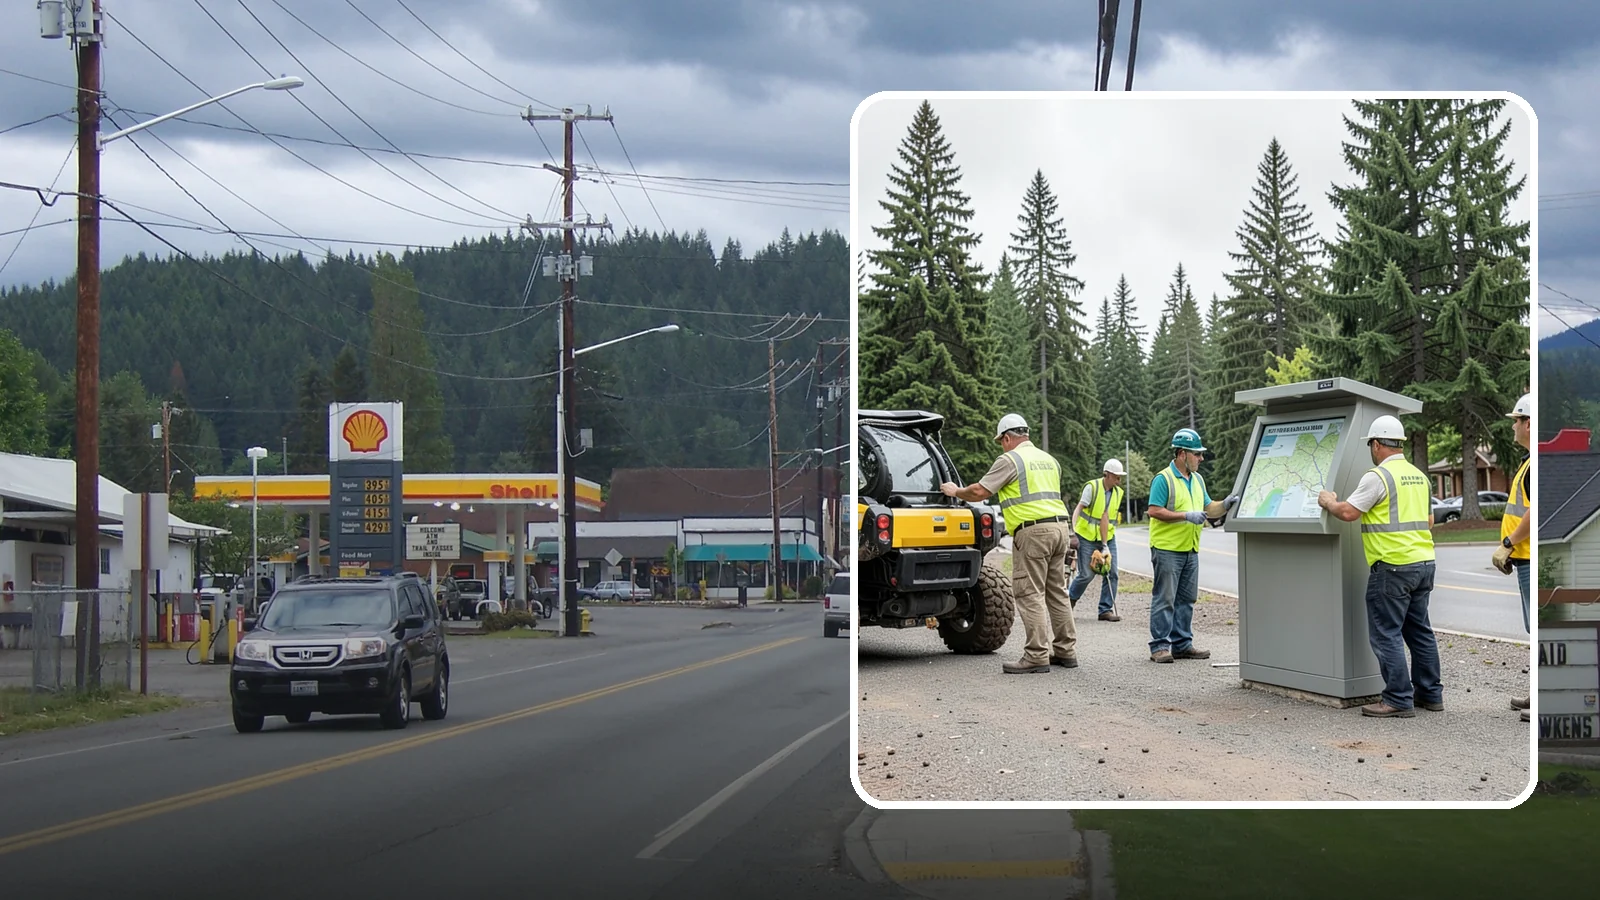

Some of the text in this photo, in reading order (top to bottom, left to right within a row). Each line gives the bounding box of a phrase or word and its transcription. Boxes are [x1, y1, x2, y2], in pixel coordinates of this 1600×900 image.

[366, 480, 383, 490] 395
[490, 485, 547, 499] Shell
[366, 494, 383, 504] 405
[366, 508, 383, 518] 415
[366, 522, 383, 533] 429
